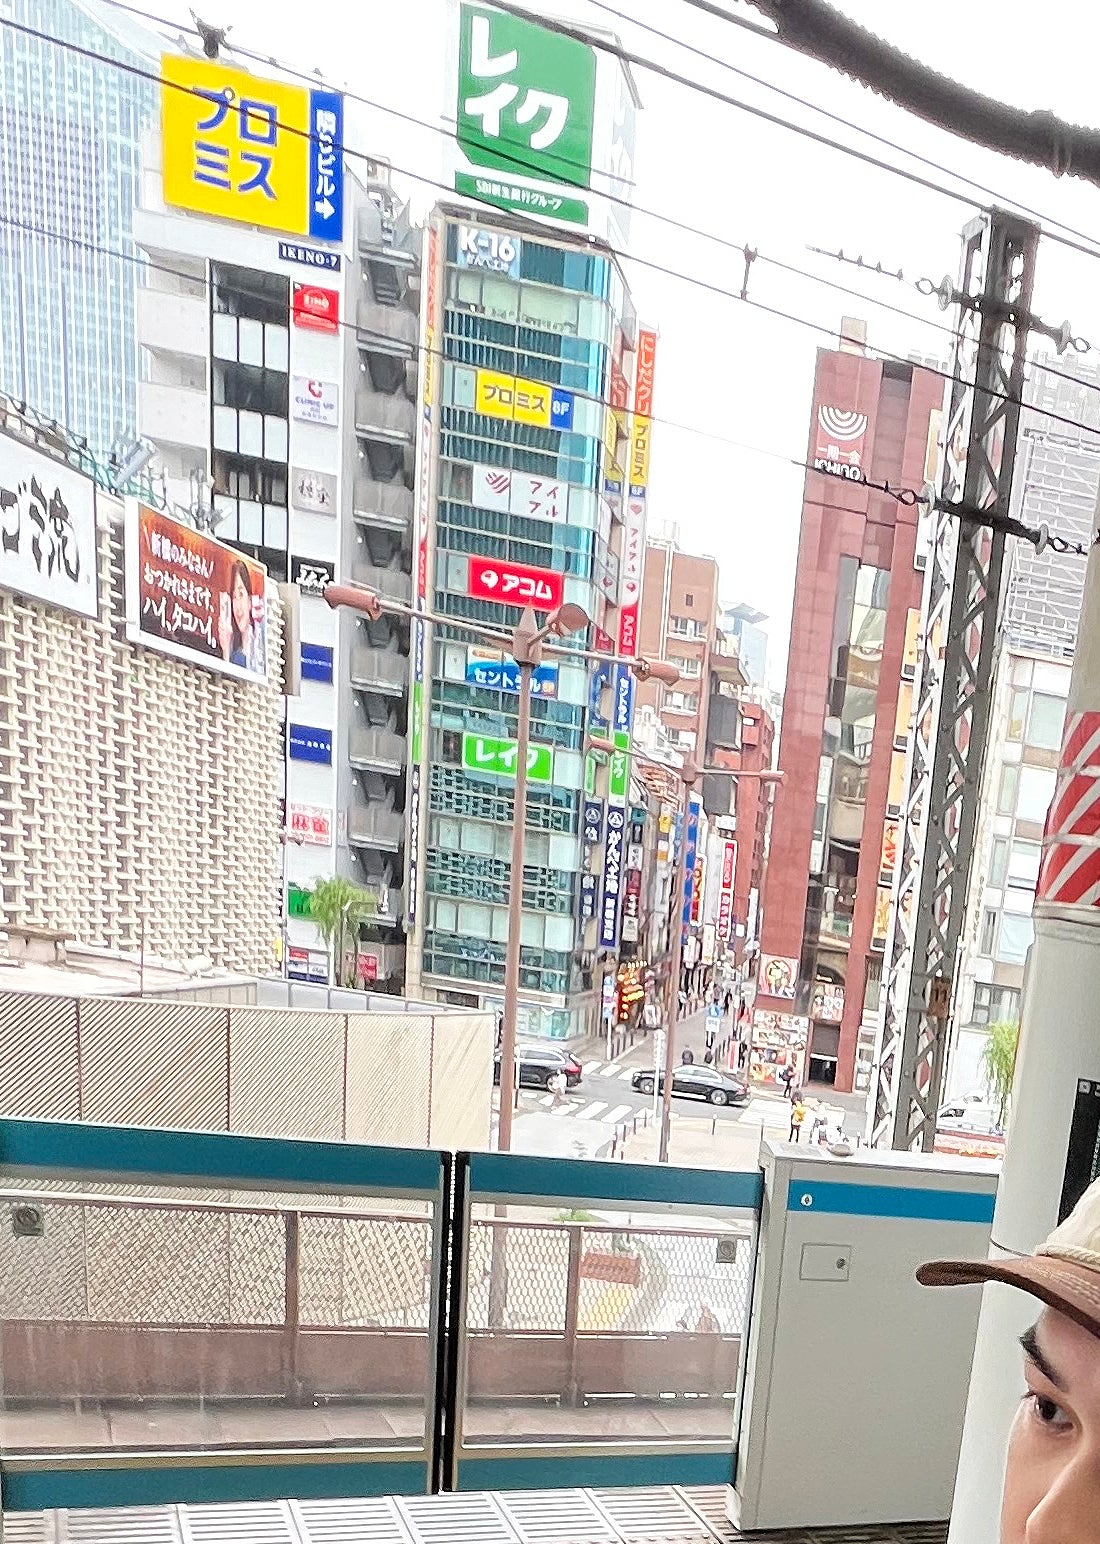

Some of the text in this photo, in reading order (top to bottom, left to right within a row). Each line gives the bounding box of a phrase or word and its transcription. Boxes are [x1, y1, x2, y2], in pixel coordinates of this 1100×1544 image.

[193, 86, 277, 147] プロ
[465, 82, 569, 150] イク
[195, 140, 277, 200] ミス
[461, 226, 515, 262] K-16
[483, 384, 546, 413] プロミス
[633, 424, 648, 478] プロミス
[501, 573, 553, 600] アコム
[475, 739, 539, 770] レイク
